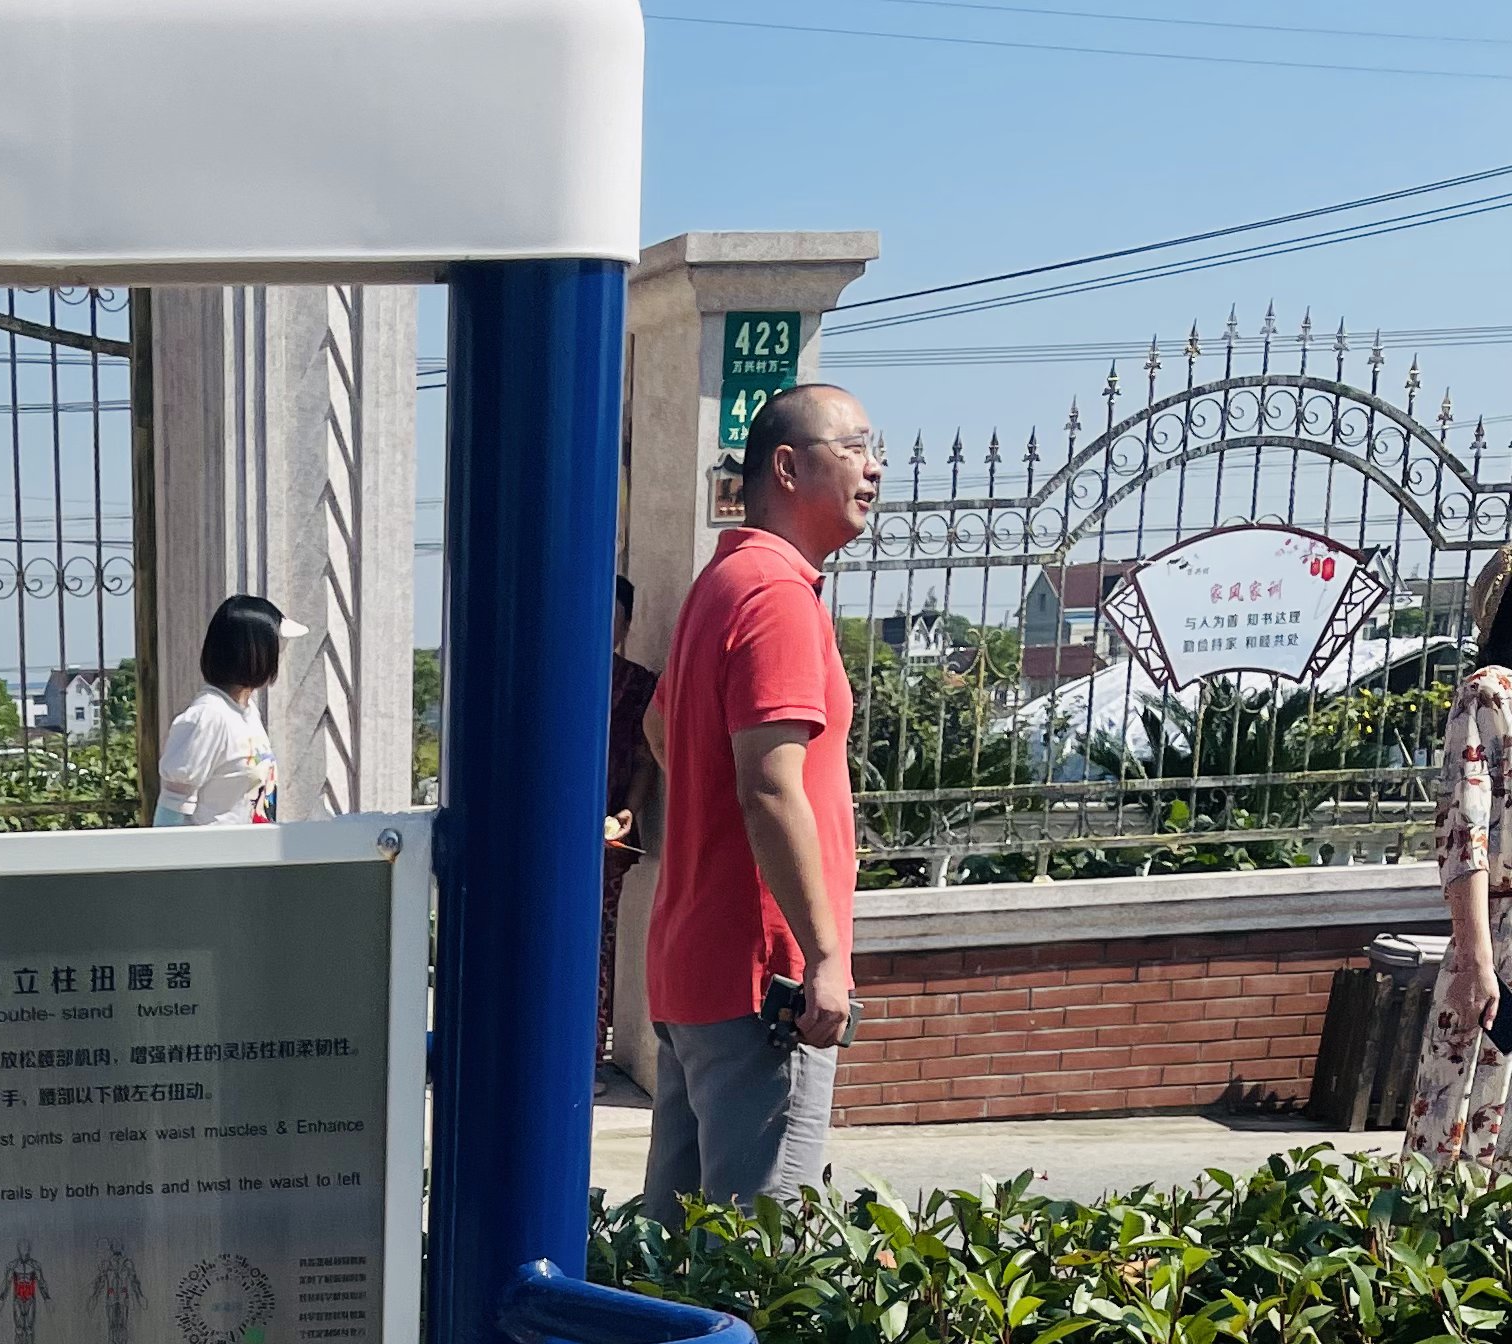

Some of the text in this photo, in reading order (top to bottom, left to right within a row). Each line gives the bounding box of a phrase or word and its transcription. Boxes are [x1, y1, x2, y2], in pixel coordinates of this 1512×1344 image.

[735, 321, 789, 355] 423
[731, 389, 783, 423] 42
[1210, 578, 1283, 604] 家风家训
[61, 1003, 114, 1021] stand
[137, 1002, 199, 1018] twister
[21, 1131, 64, 1150] joints
[71, 1128, 101, 1144] and
[108, 1126, 148, 1142] relax
[155, 1125, 196, 1141] waist
[204, 1122, 268, 1138] muscles
[275, 1120, 288, 1135] &
[296, 1119, 365, 1135] Enhance
[39, 1185, 59, 1203] by
[65, 1182, 100, 1198] both
[106, 1180, 154, 1197] hands
[161, 1178, 190, 1195] and
[196, 1176, 231, 1193] twist
[238, 1176, 263, 1191] the
[269, 1174, 310, 1189] waist
[316, 1173, 332, 1188] to
[337, 1171, 361, 1187] left
